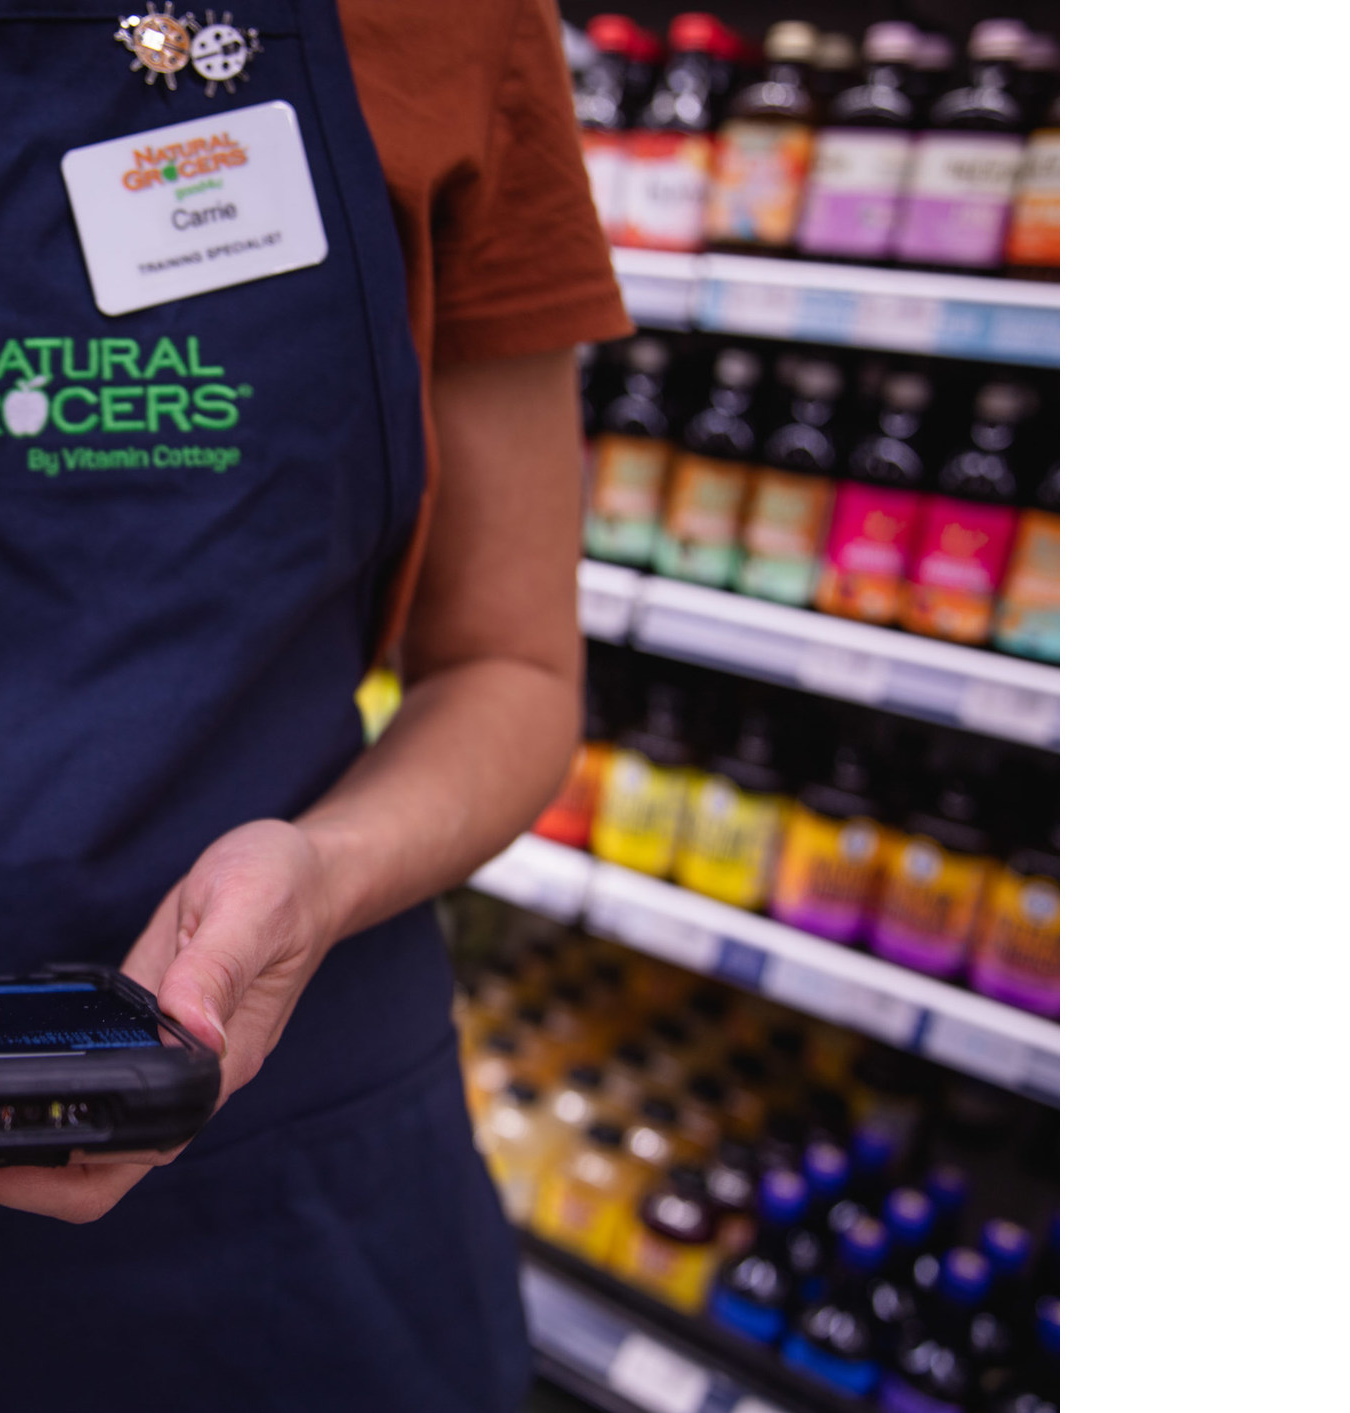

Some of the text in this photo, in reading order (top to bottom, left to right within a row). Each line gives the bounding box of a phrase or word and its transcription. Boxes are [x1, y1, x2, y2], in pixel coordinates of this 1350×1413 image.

[134, 134, 238, 168] NATURAL
[171, 200, 237, 230] Carrie
[139, 232, 281, 273] TRAINING SPECIALIST
[28, 444, 241, 477] By Vitamin Cottage
